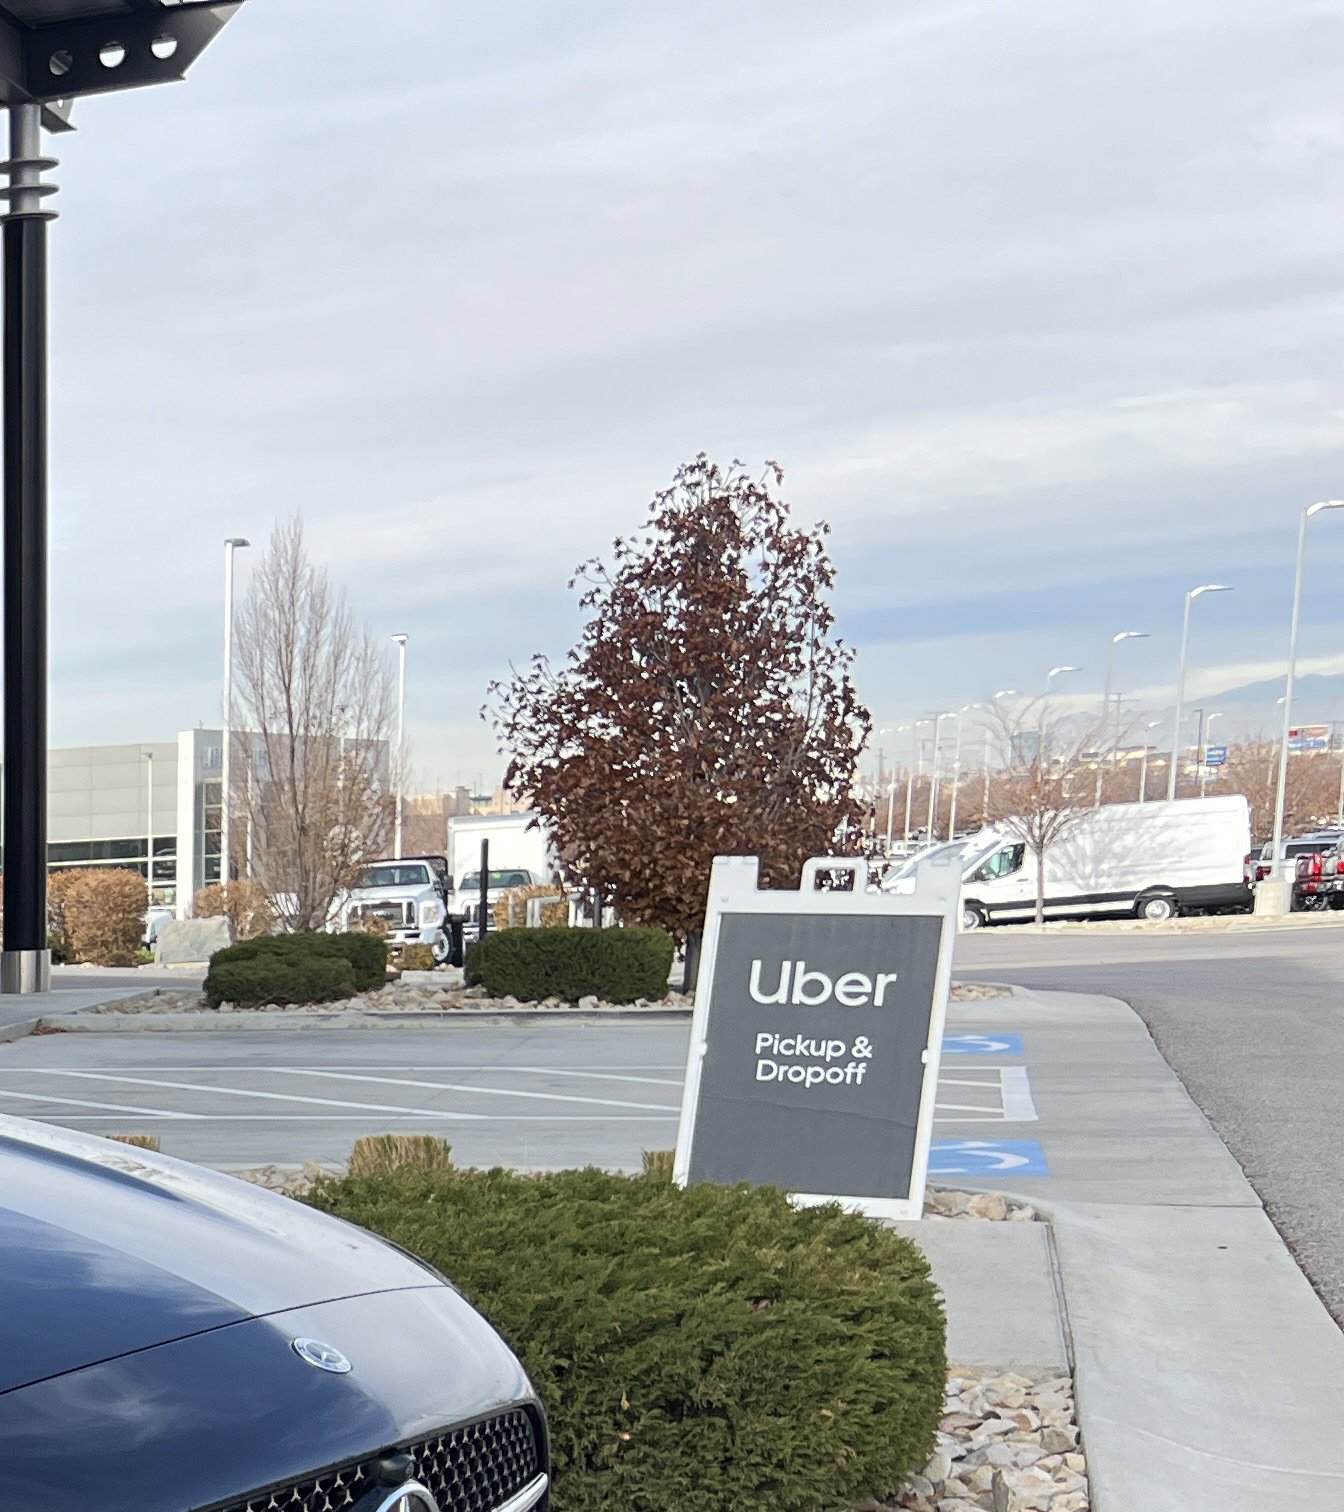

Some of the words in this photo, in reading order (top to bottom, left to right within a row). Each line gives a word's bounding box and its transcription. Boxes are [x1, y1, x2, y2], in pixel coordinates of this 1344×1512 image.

[749, 959, 898, 1007] Uber
[755, 1032, 846, 1062] Pickup
[851, 1036, 873, 1059] &
[755, 1059, 867, 1088] Dropoff
